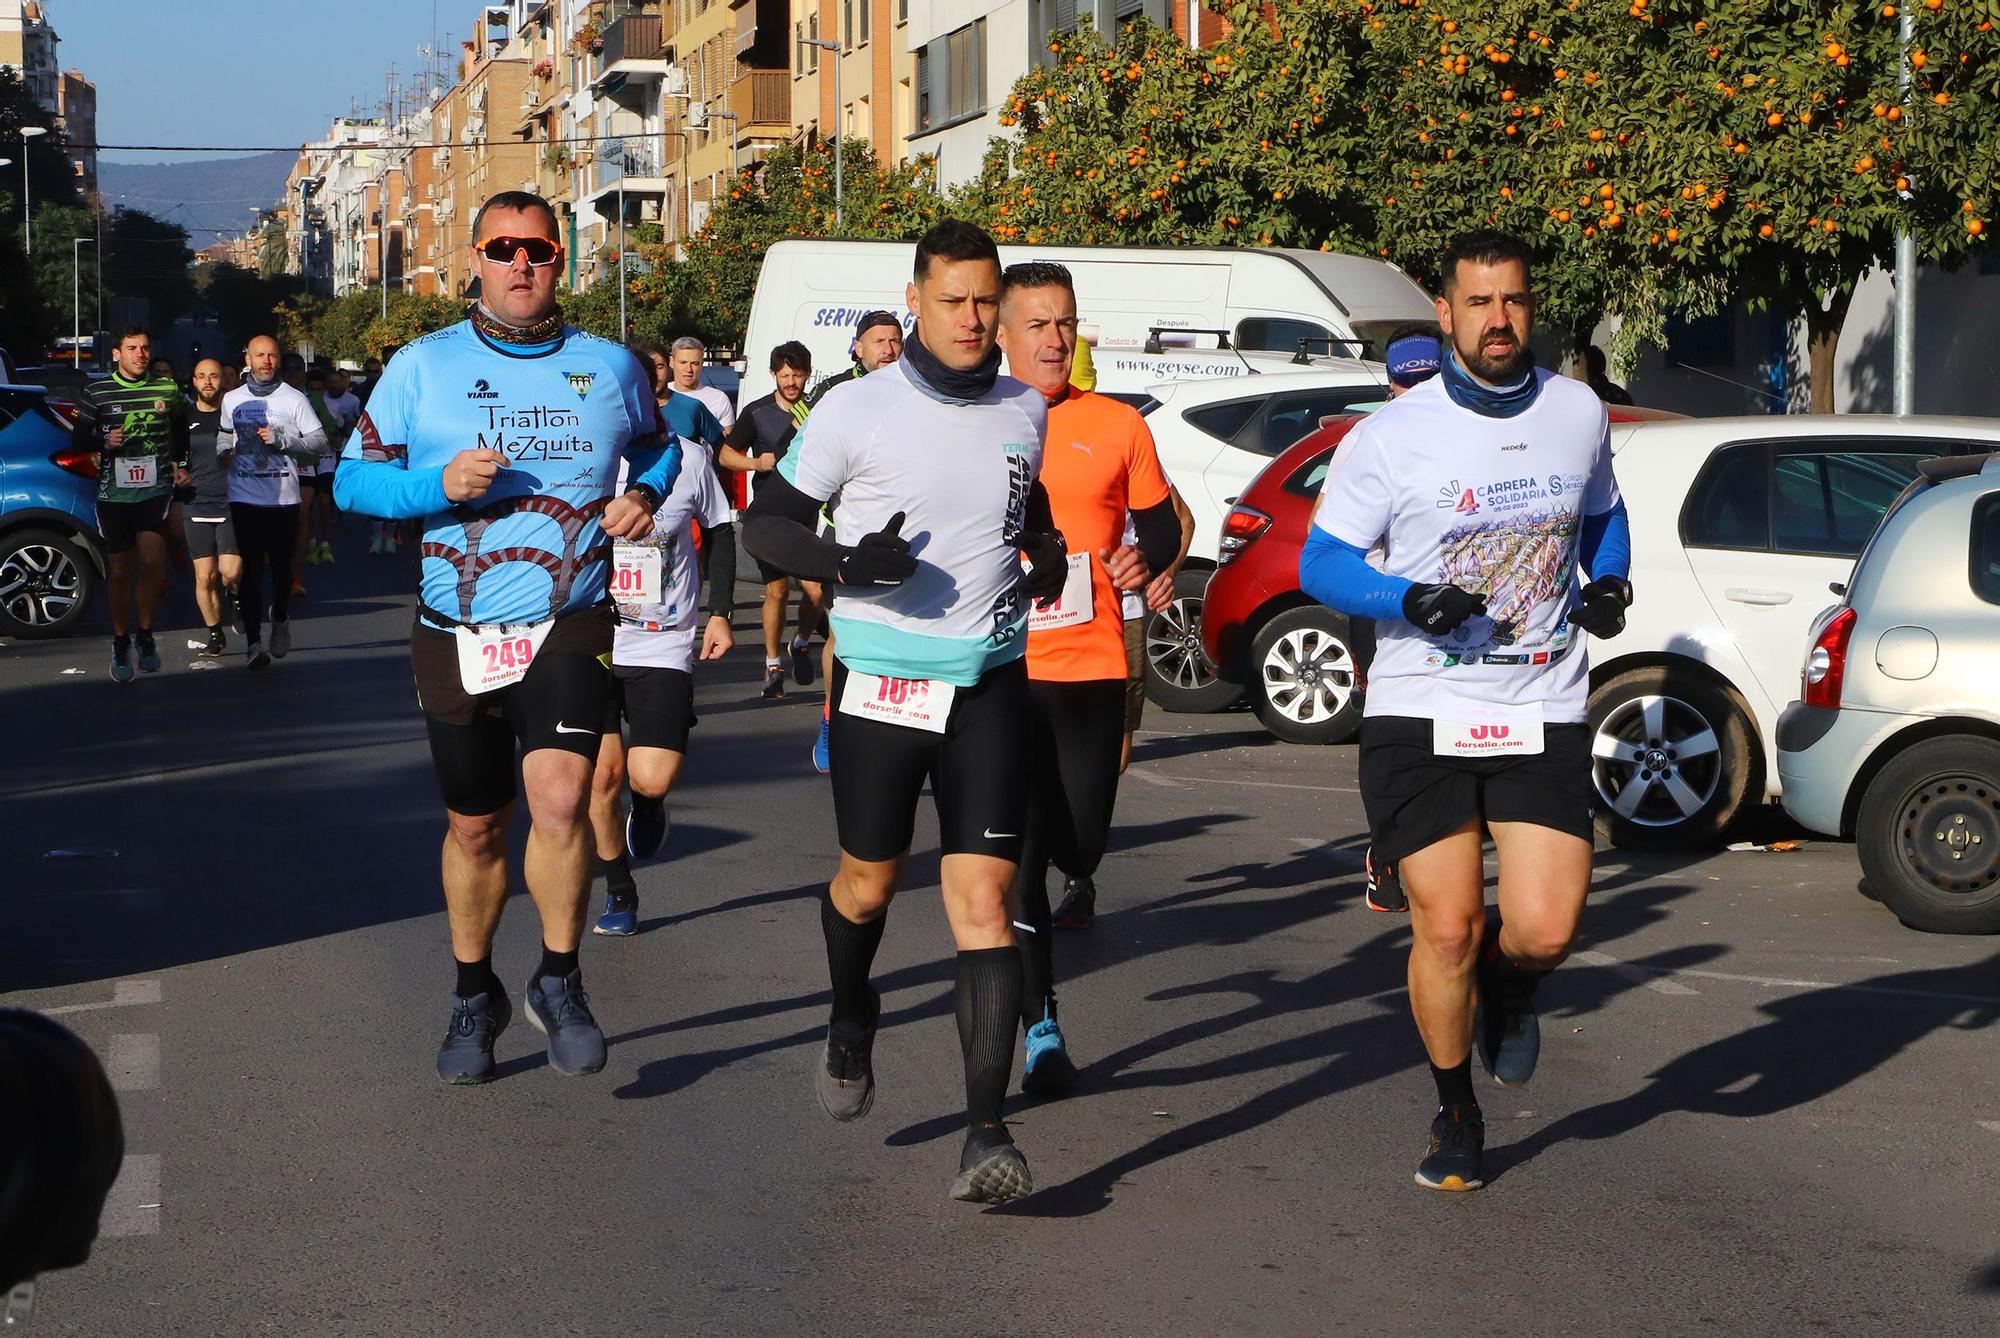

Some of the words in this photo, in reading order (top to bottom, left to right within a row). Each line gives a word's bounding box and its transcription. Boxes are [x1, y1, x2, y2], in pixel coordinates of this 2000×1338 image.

[1156, 318, 1189, 327] Después
[1116, 360, 1240, 379] www.geyse.com
[127, 468, 145, 481] 117
[1455, 488, 1480, 514] 4
[1476, 477, 1537, 497] CARRERA
[1488, 488, 1548, 507] SOLIDARIA
[610, 569, 642, 590] 201
[1028, 610, 1078, 623] orsalia.com
[482, 638, 533, 674] 249
[481, 667, 528, 684] dorsalia.co
